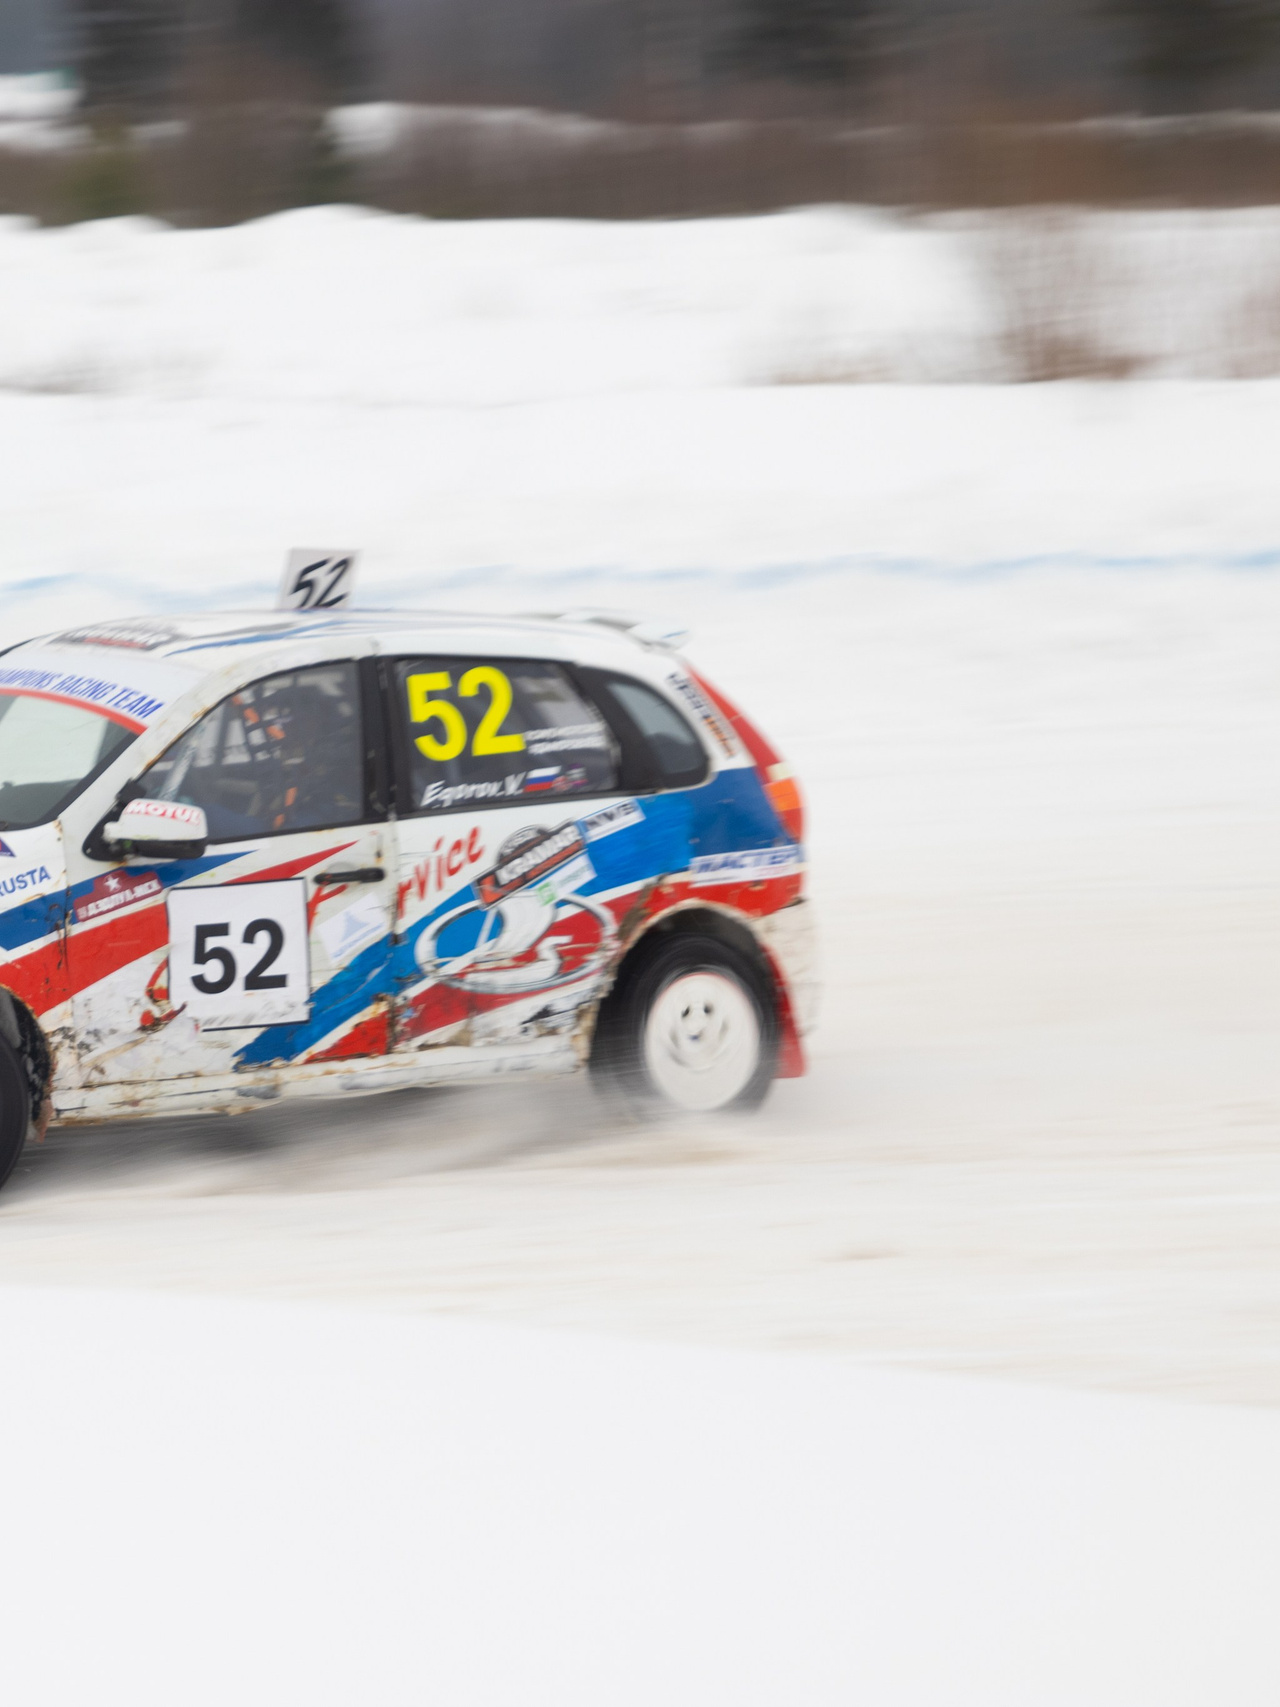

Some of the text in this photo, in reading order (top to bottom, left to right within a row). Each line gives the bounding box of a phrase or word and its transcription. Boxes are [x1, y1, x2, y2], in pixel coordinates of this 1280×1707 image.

[288, 556, 354, 608] 52
[51, 674, 118, 701] RACING
[106, 686, 165, 719] TEAM
[406, 666, 527, 761] 52
[123, 801, 202, 826] MOTUL
[191, 918, 288, 995] 52
